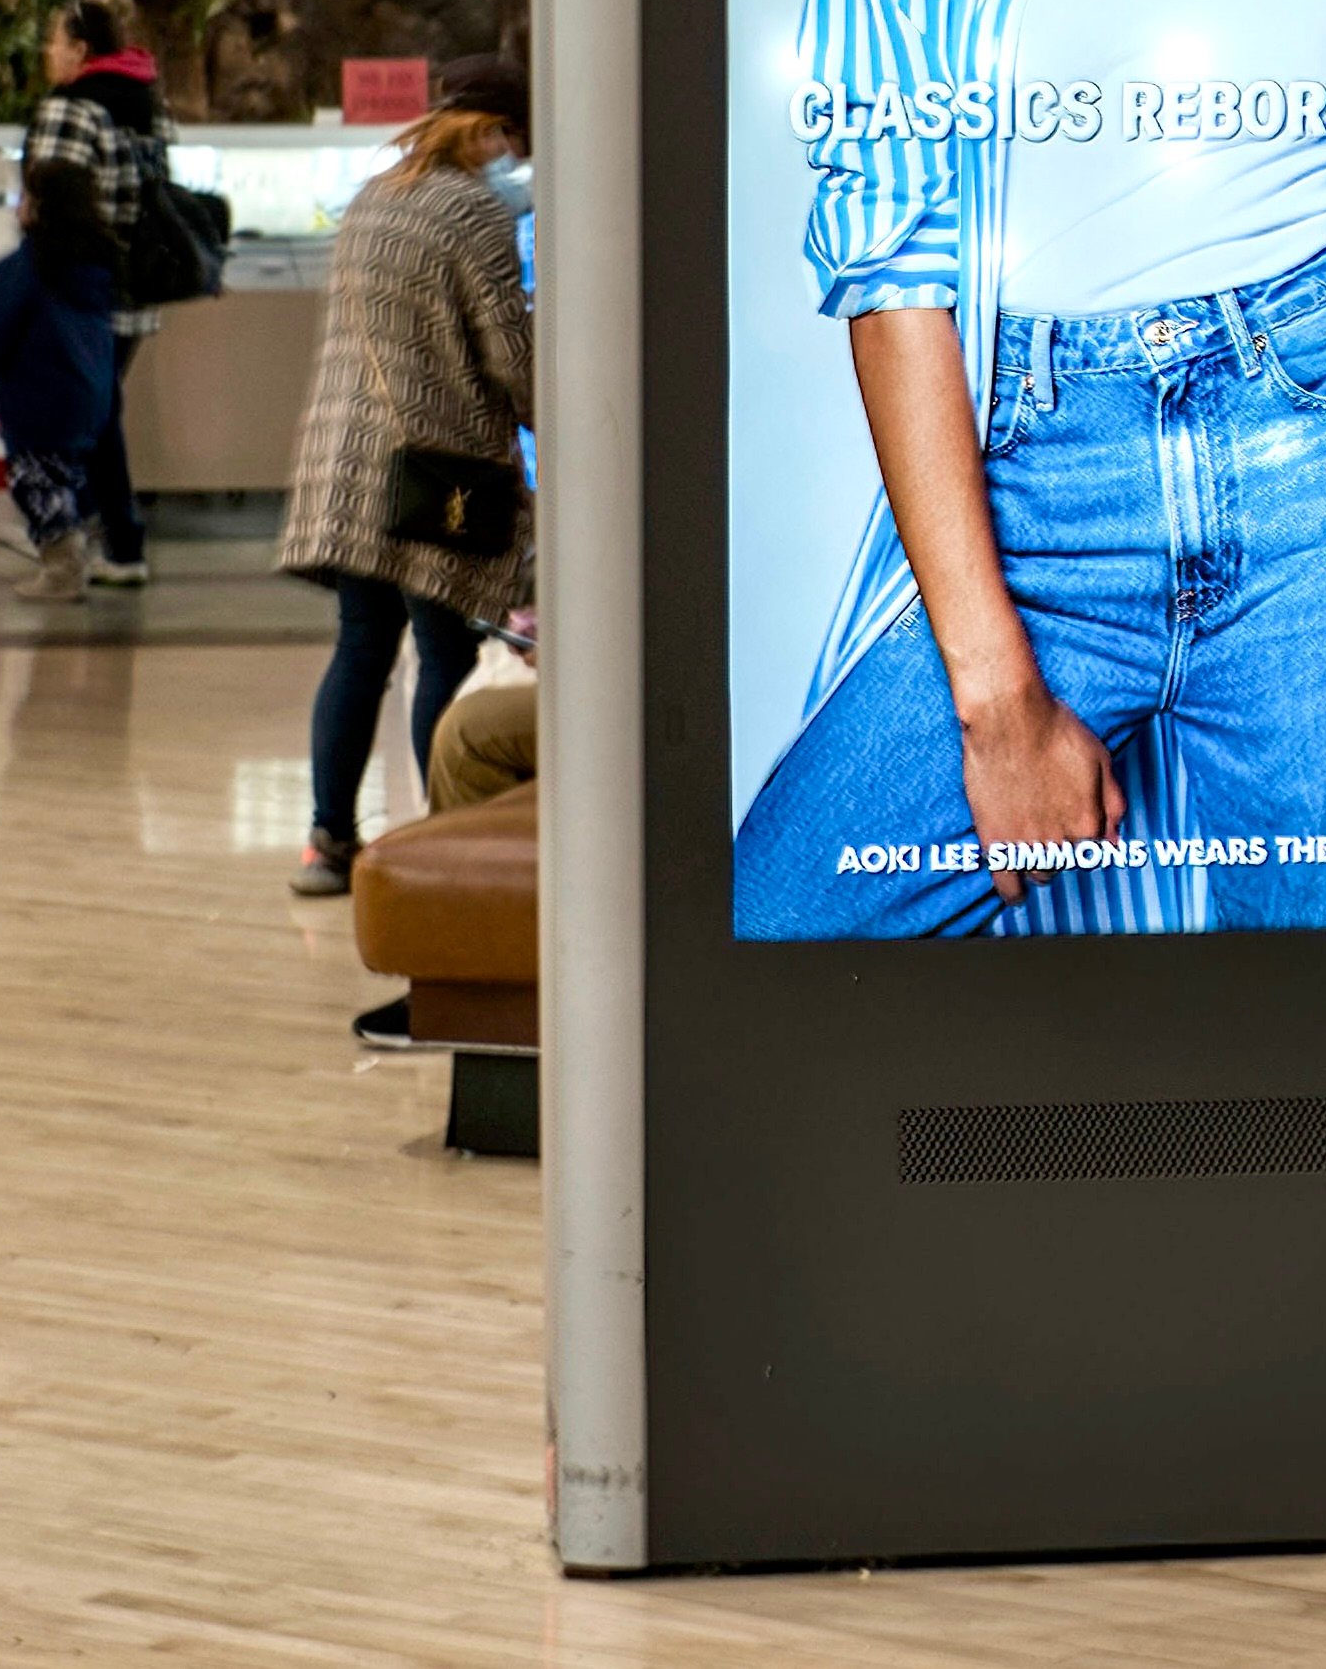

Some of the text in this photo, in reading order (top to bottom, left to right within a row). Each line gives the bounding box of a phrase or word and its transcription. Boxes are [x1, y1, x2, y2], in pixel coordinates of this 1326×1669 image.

[788, 80, 1103, 144] CLASSICS
[837, 845, 921, 874] AOKI
[930, 843, 980, 872] LEE
[987, 839, 1148, 872] SIMMONS
[1154, 837, 1269, 867] WEARS
